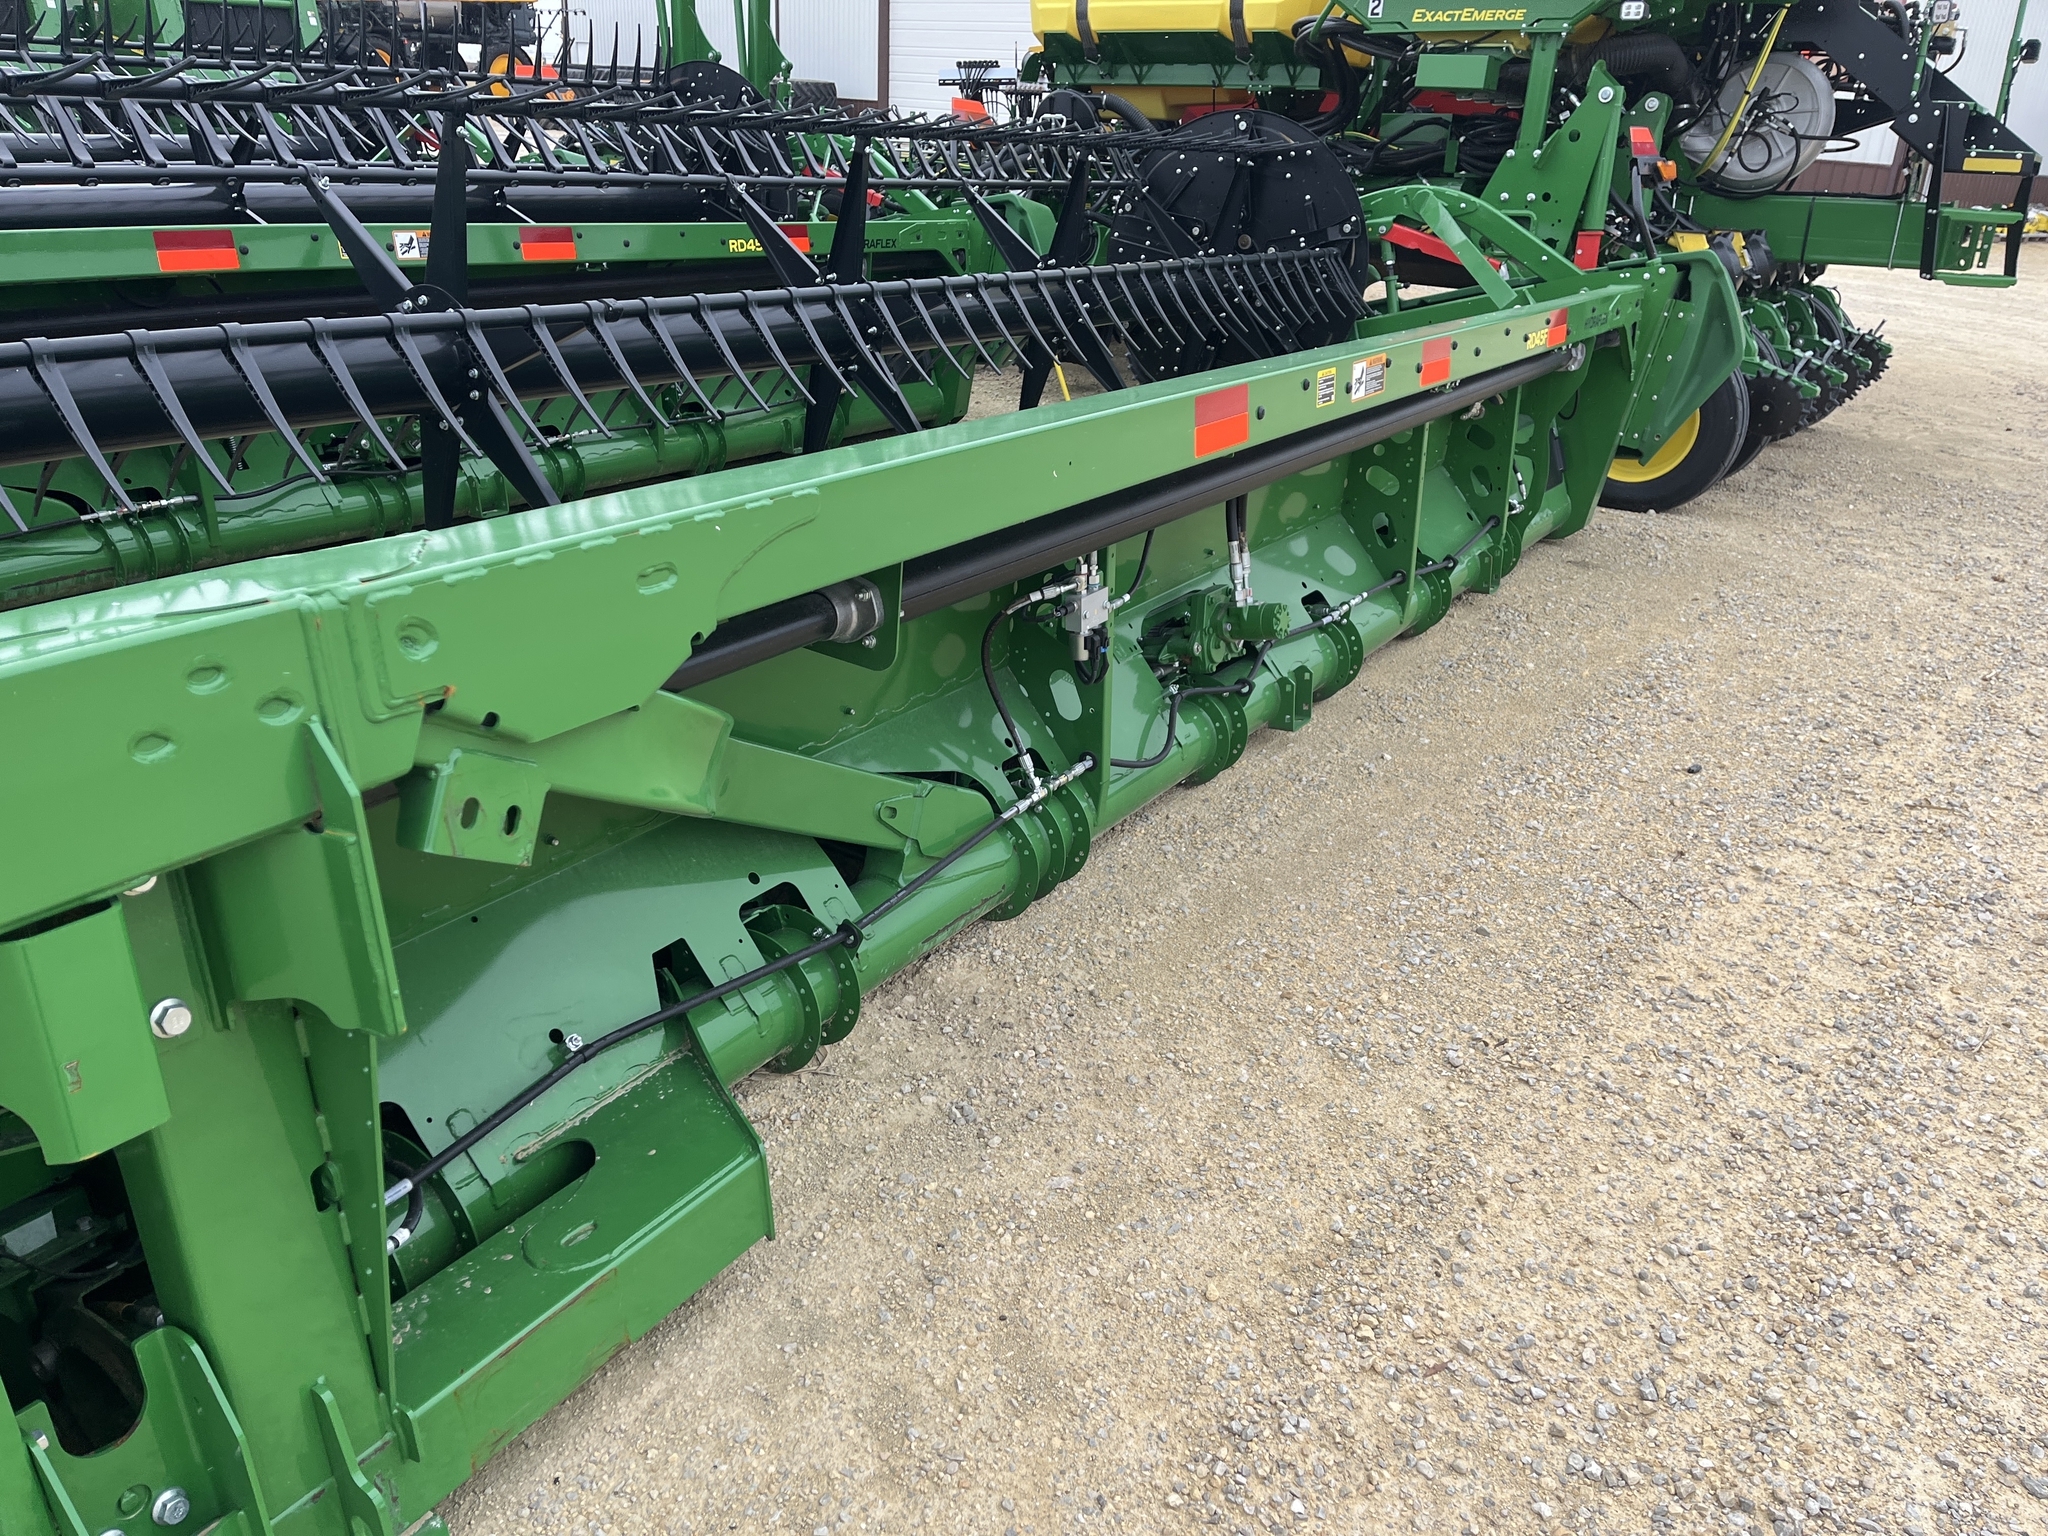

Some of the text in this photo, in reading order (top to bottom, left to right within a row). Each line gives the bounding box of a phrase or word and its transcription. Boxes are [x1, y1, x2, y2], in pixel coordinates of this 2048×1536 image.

[1370, 0, 1381, 16] 2
[728, 238, 763, 253] RD45
[863, 238, 897, 249] RAFLEX
